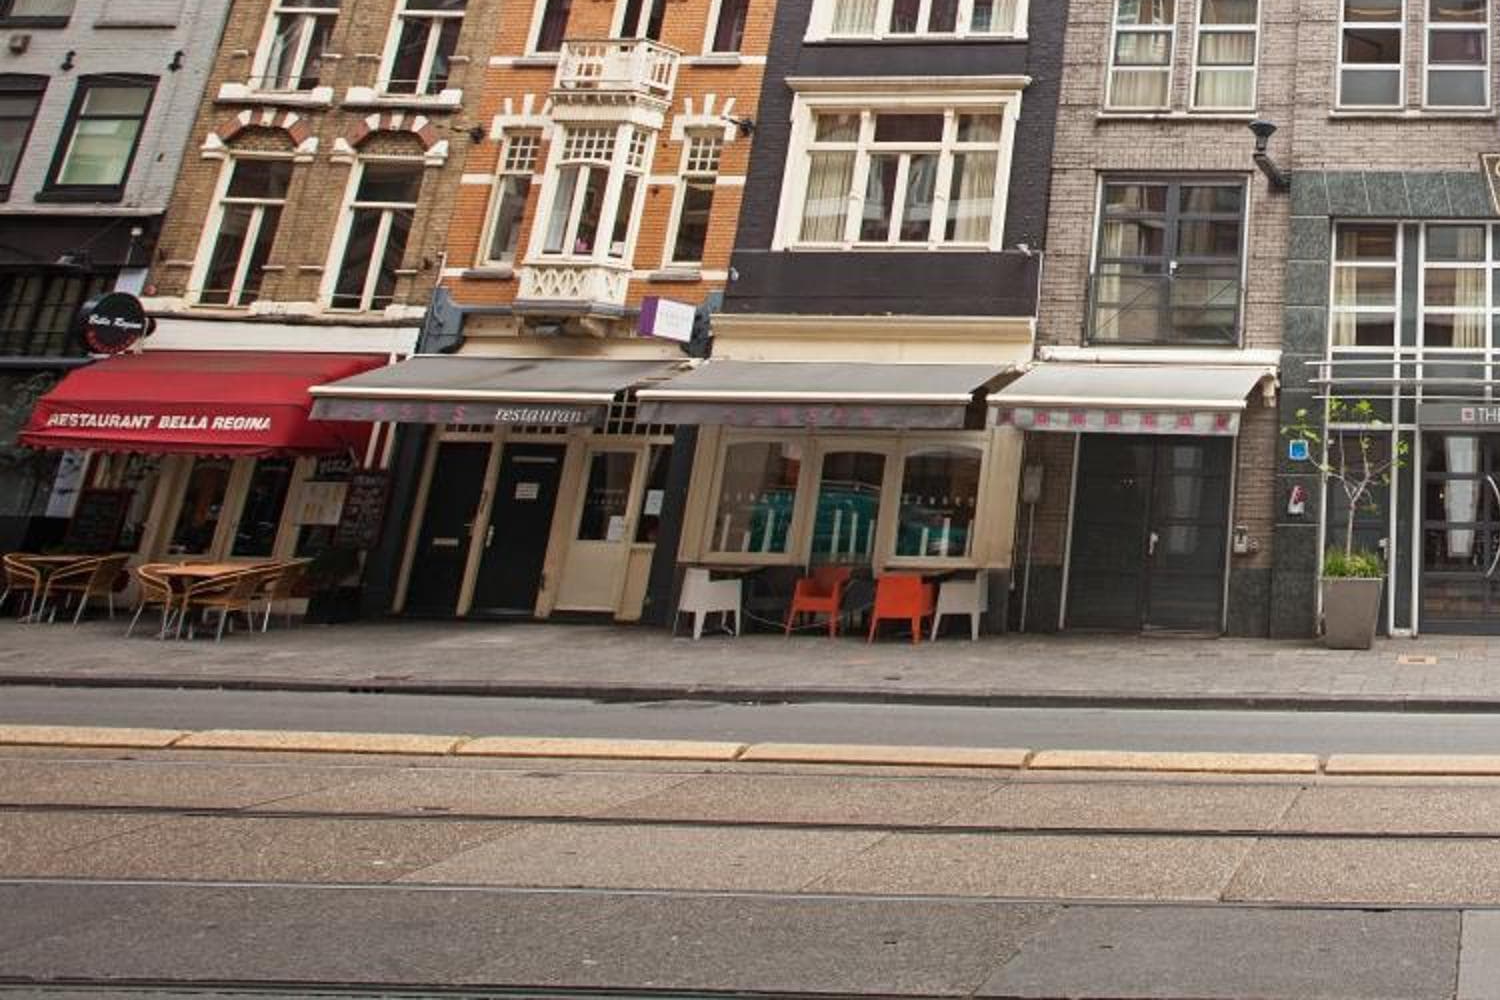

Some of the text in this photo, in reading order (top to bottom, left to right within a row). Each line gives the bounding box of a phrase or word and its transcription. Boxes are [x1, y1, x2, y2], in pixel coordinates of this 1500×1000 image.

[48, 413, 271, 431] RESTAURANT BELLA REGINA
